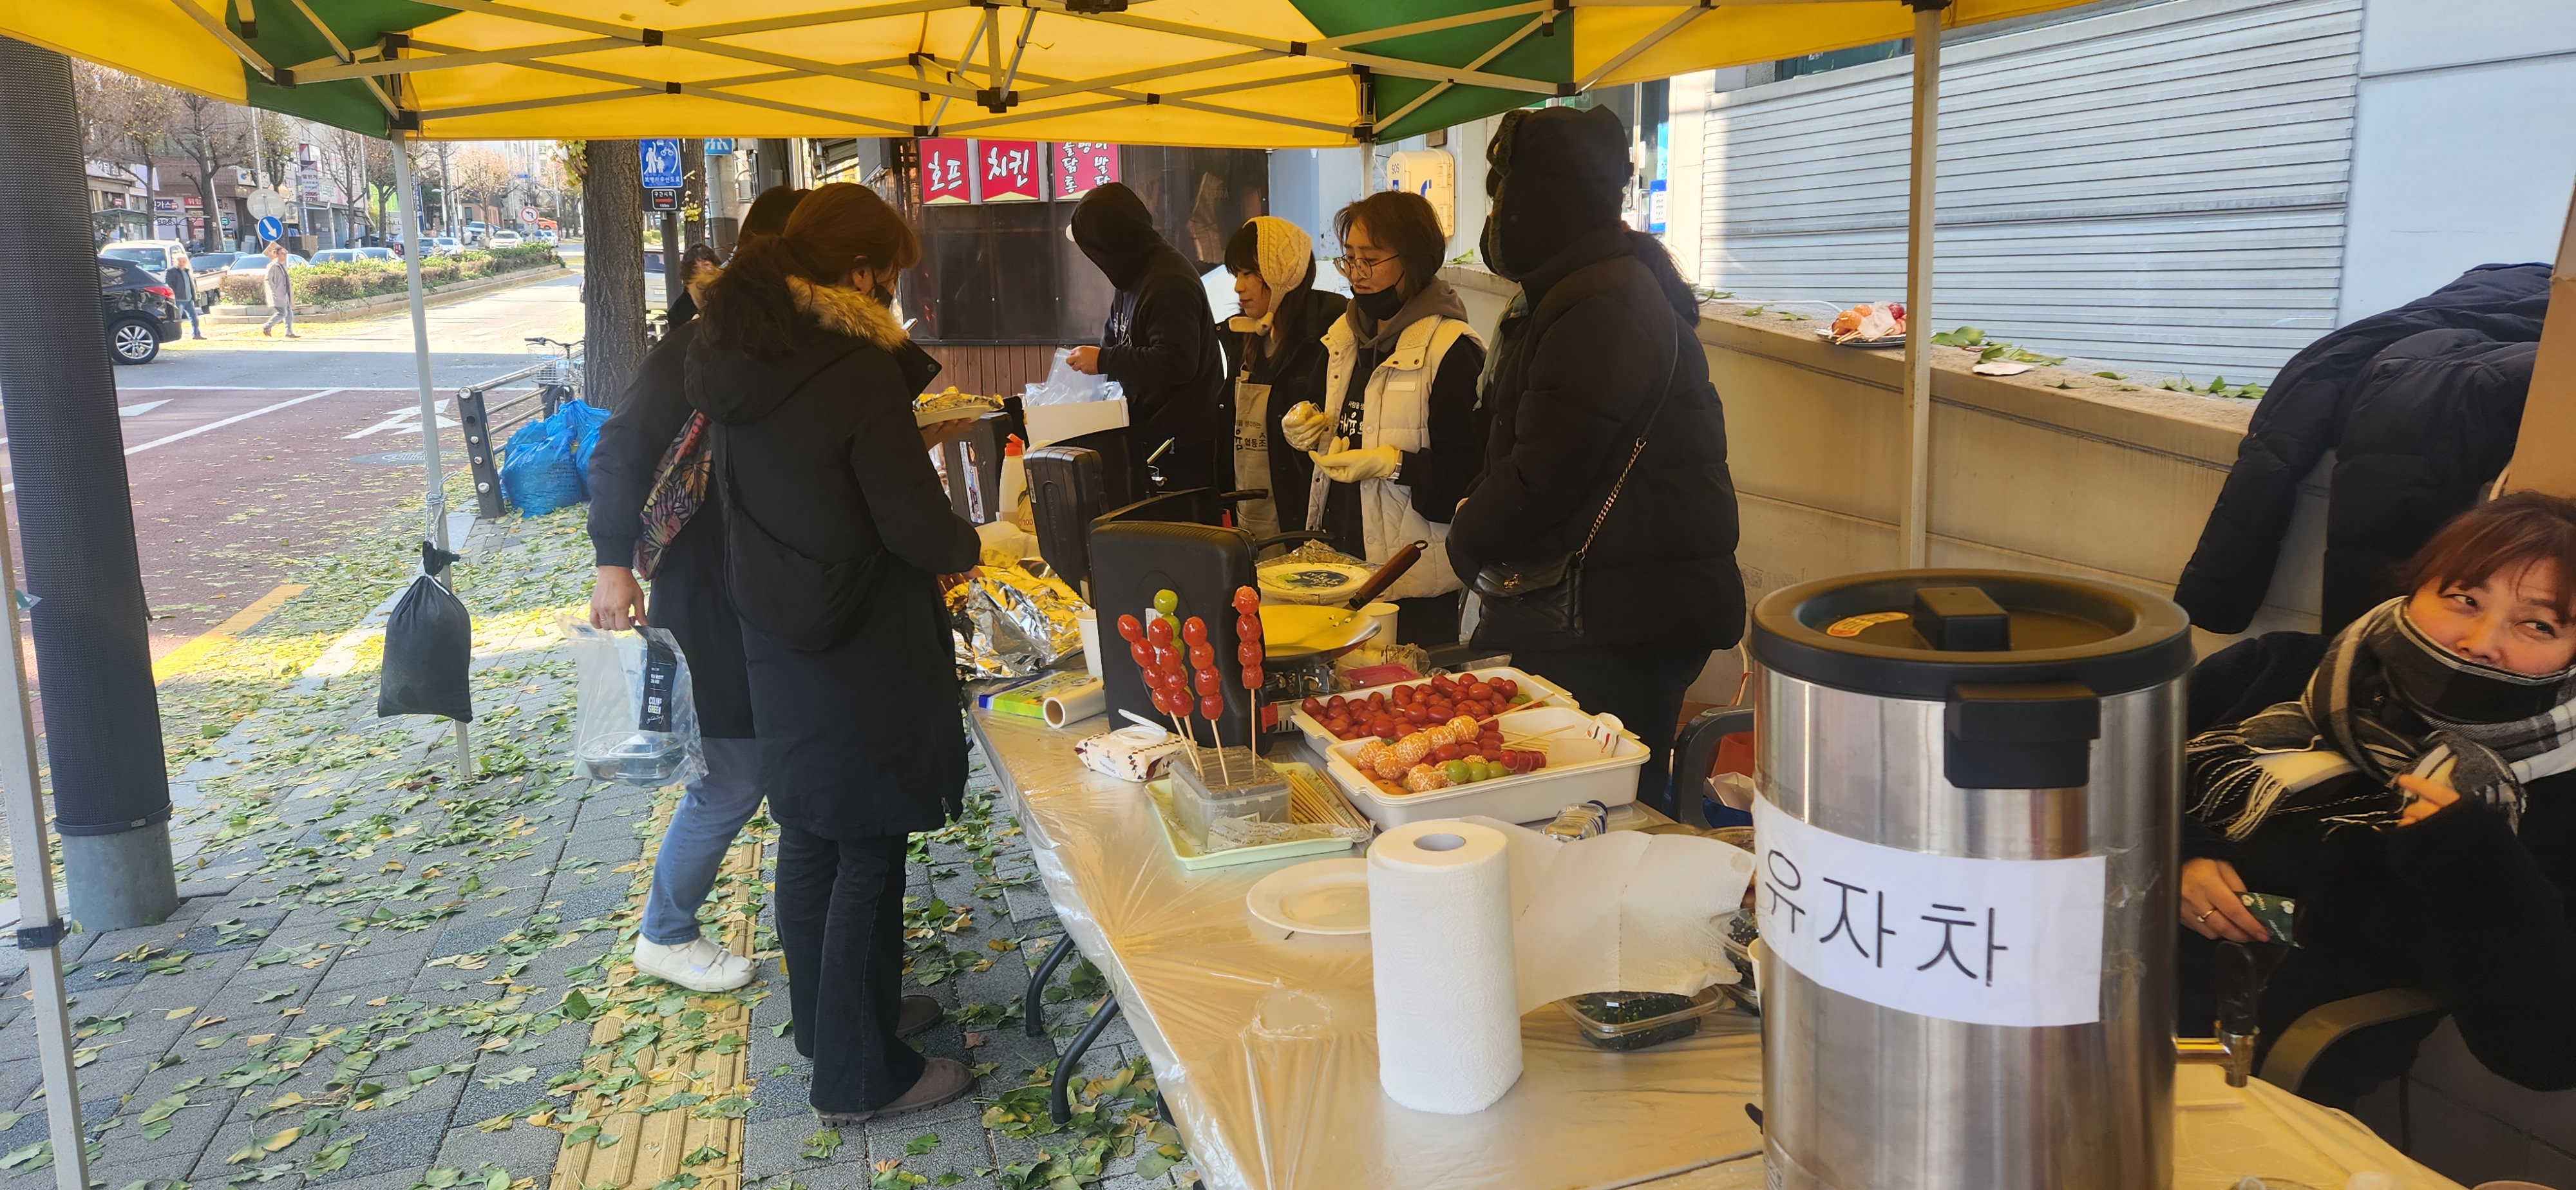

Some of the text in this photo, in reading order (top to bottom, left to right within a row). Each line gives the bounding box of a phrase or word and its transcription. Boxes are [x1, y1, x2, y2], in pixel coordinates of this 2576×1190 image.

[928, 150, 962, 192] 호프
[987, 146, 1030, 188] 치킨
[1348, 401, 1359, 410] 사람을
[647, 704, 661, 715] GREEN
[1765, 849, 2009, 987] 유자차
